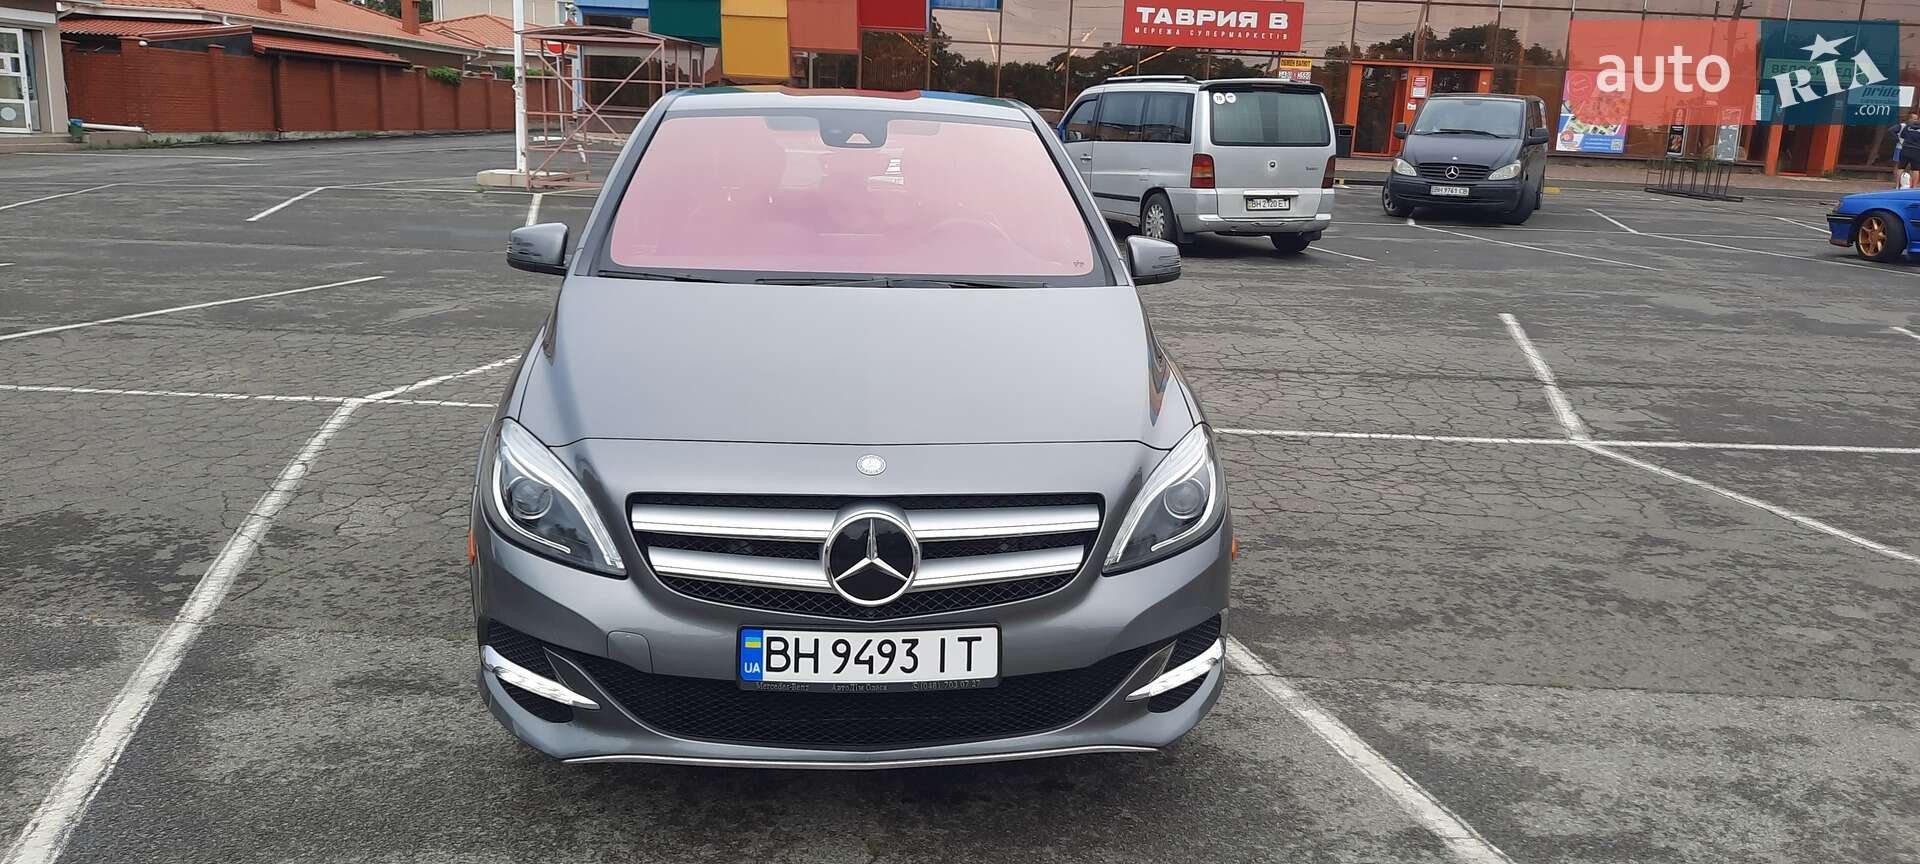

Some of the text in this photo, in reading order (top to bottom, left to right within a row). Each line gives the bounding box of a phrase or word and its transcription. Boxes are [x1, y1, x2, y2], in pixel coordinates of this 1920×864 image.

[1136, 7, 1288, 29] ТАВРИЯ В
[1135, 27, 1288, 40] МЕРЕЖА СУПЕРМАРКЕТІВ
[765, 636, 819, 674] BH
[831, 638, 919, 674] 9493
[744, 662, 761, 674] UA
